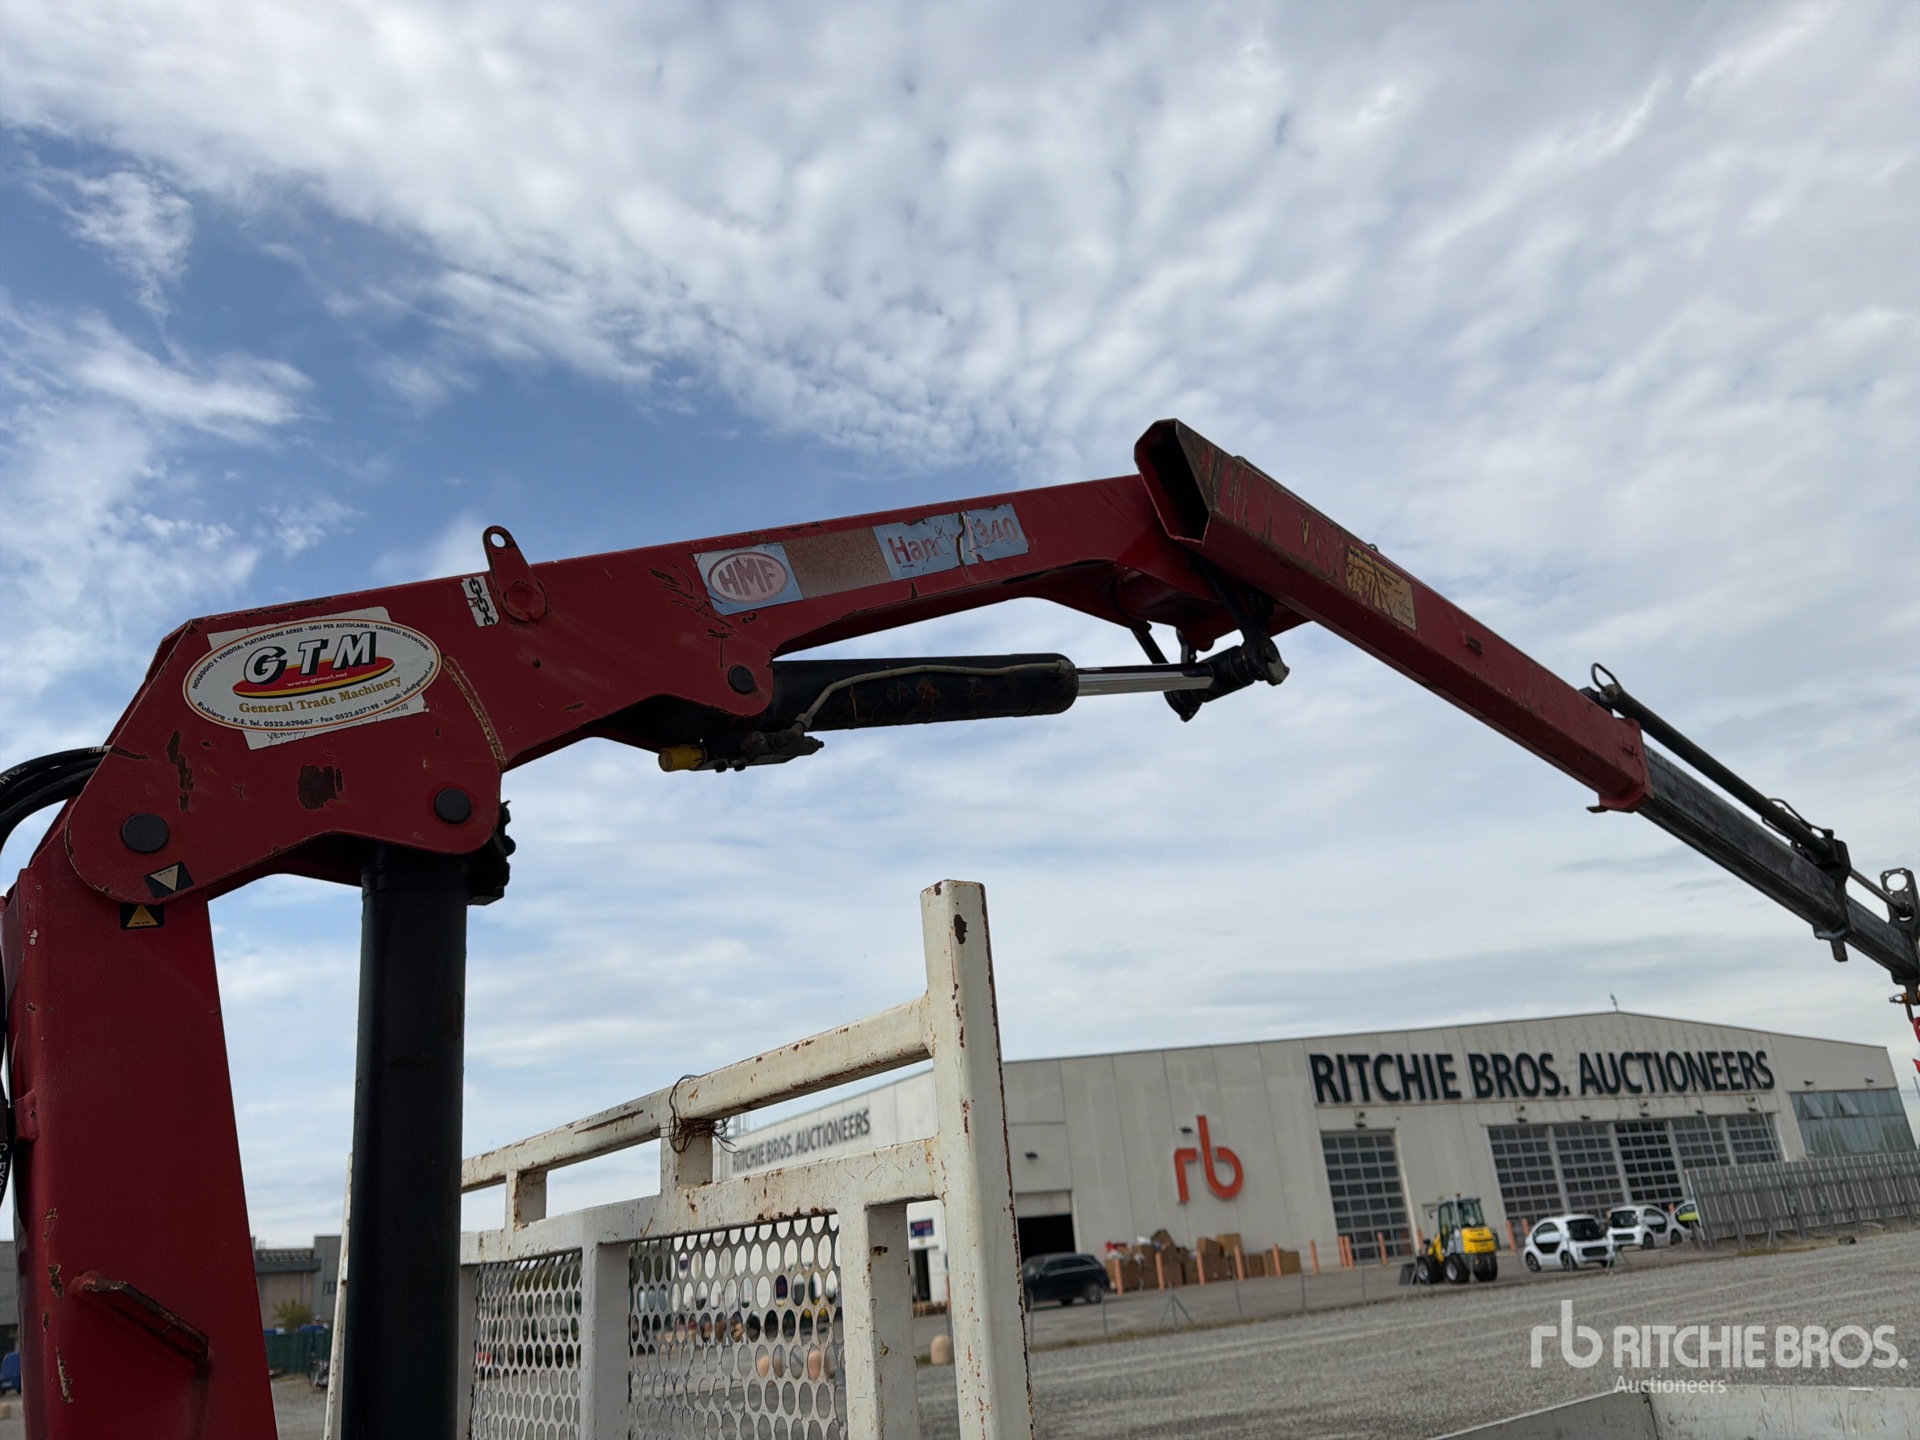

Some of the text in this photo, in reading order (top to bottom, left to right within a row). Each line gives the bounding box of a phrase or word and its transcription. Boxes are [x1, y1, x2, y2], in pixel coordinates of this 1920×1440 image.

[718, 557, 775, 596] HMF
[192, 662, 214, 690] NOLEGGIO
[218, 645, 244, 661] VENDITA:
[244, 631, 284, 649] PIATTAFORME
[286, 627, 303, 636] AEREE
[375, 624, 401, 635] CARRELLI
[402, 632, 429, 651] ELEVATORI
[243, 631, 377, 686] GTM
[286, 672, 347, 687] www.gtmsrl.net
[197, 701, 225, 720] Rubiera
[233, 717, 247, 725] R.E.
[264, 718, 314, 727] 0522.629667
[335, 702, 379, 720] 0522.627198
[384, 693, 403, 705] Email:
[402, 660, 435, 695] info@gtmsrl.net
[239, 676, 401, 713] General Trade Machinery
[1309, 1050, 1776, 1104] RITCHIE BROS. AUCTIONEERS
[766, 1134, 795, 1162] BROS.
[796, 1109, 871, 1155] AUCTIONEERS
[1173, 1114, 1244, 1204] rb
